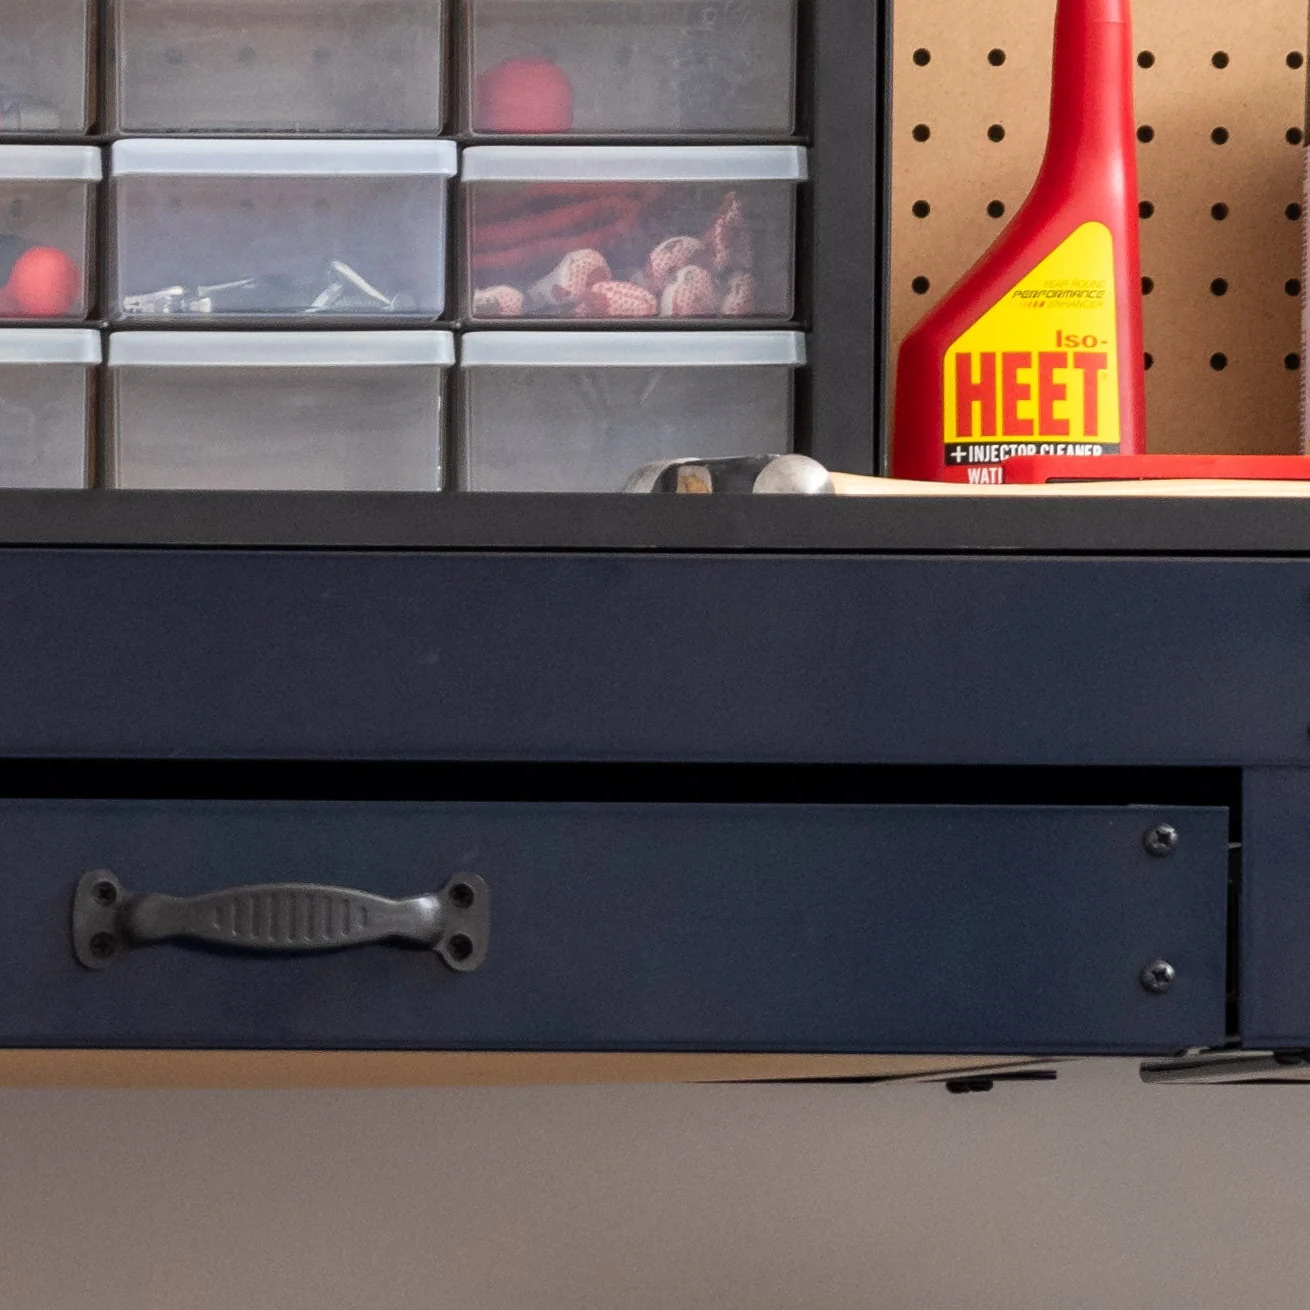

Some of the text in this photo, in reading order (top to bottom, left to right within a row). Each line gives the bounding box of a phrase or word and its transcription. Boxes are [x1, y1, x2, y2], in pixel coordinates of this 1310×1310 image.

[1012, 289, 1106, 299] PERFORMANCE
[1055, 329, 1109, 348] Iso-
[955, 352, 1108, 437] HEET
